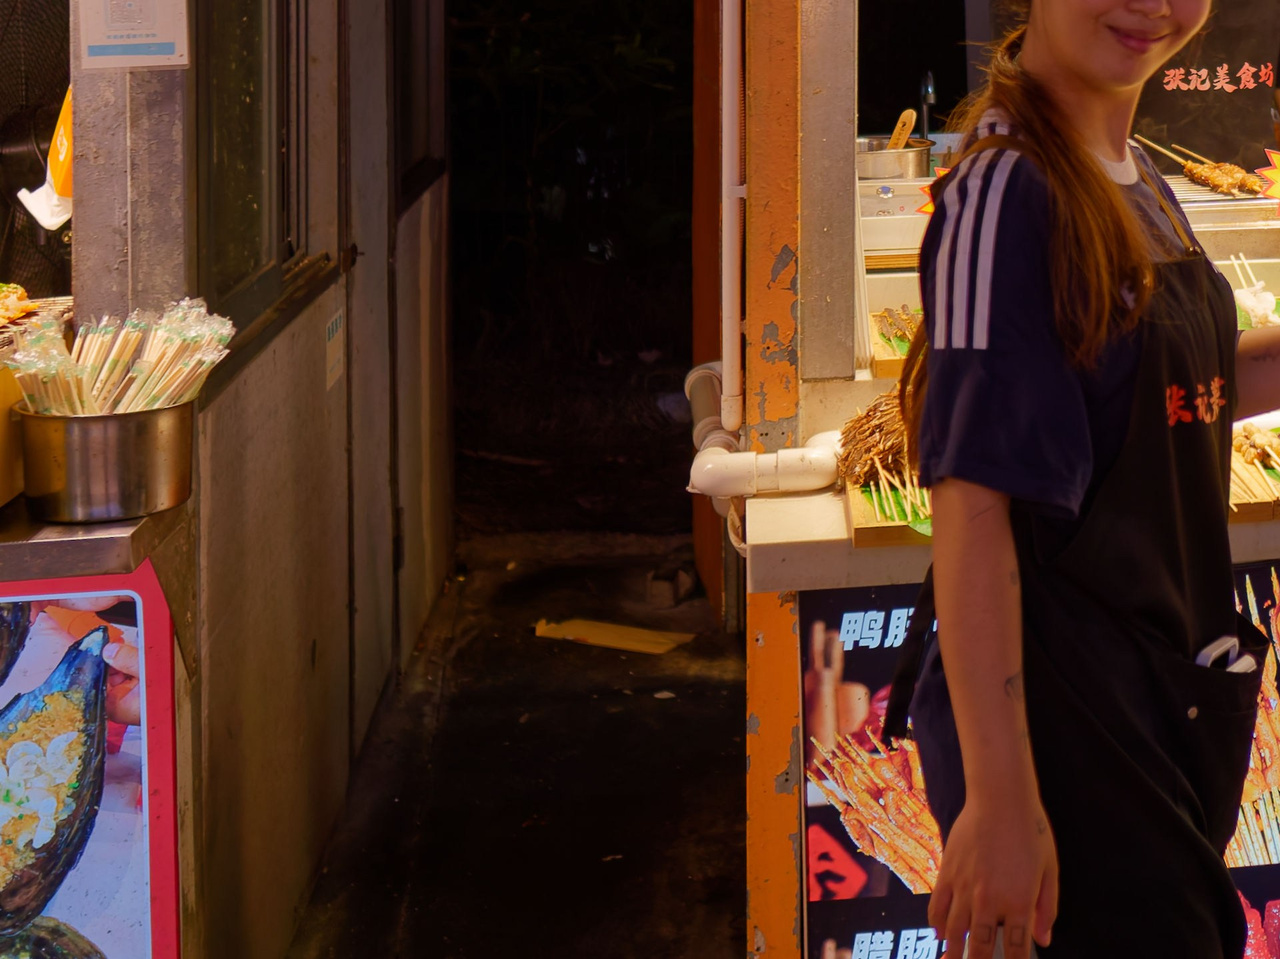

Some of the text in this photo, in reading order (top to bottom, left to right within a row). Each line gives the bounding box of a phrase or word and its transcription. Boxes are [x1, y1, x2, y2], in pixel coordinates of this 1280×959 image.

[1163, 61, 1275, 94] 张记美食坊
[851, 927, 947, 959] 腊肠
